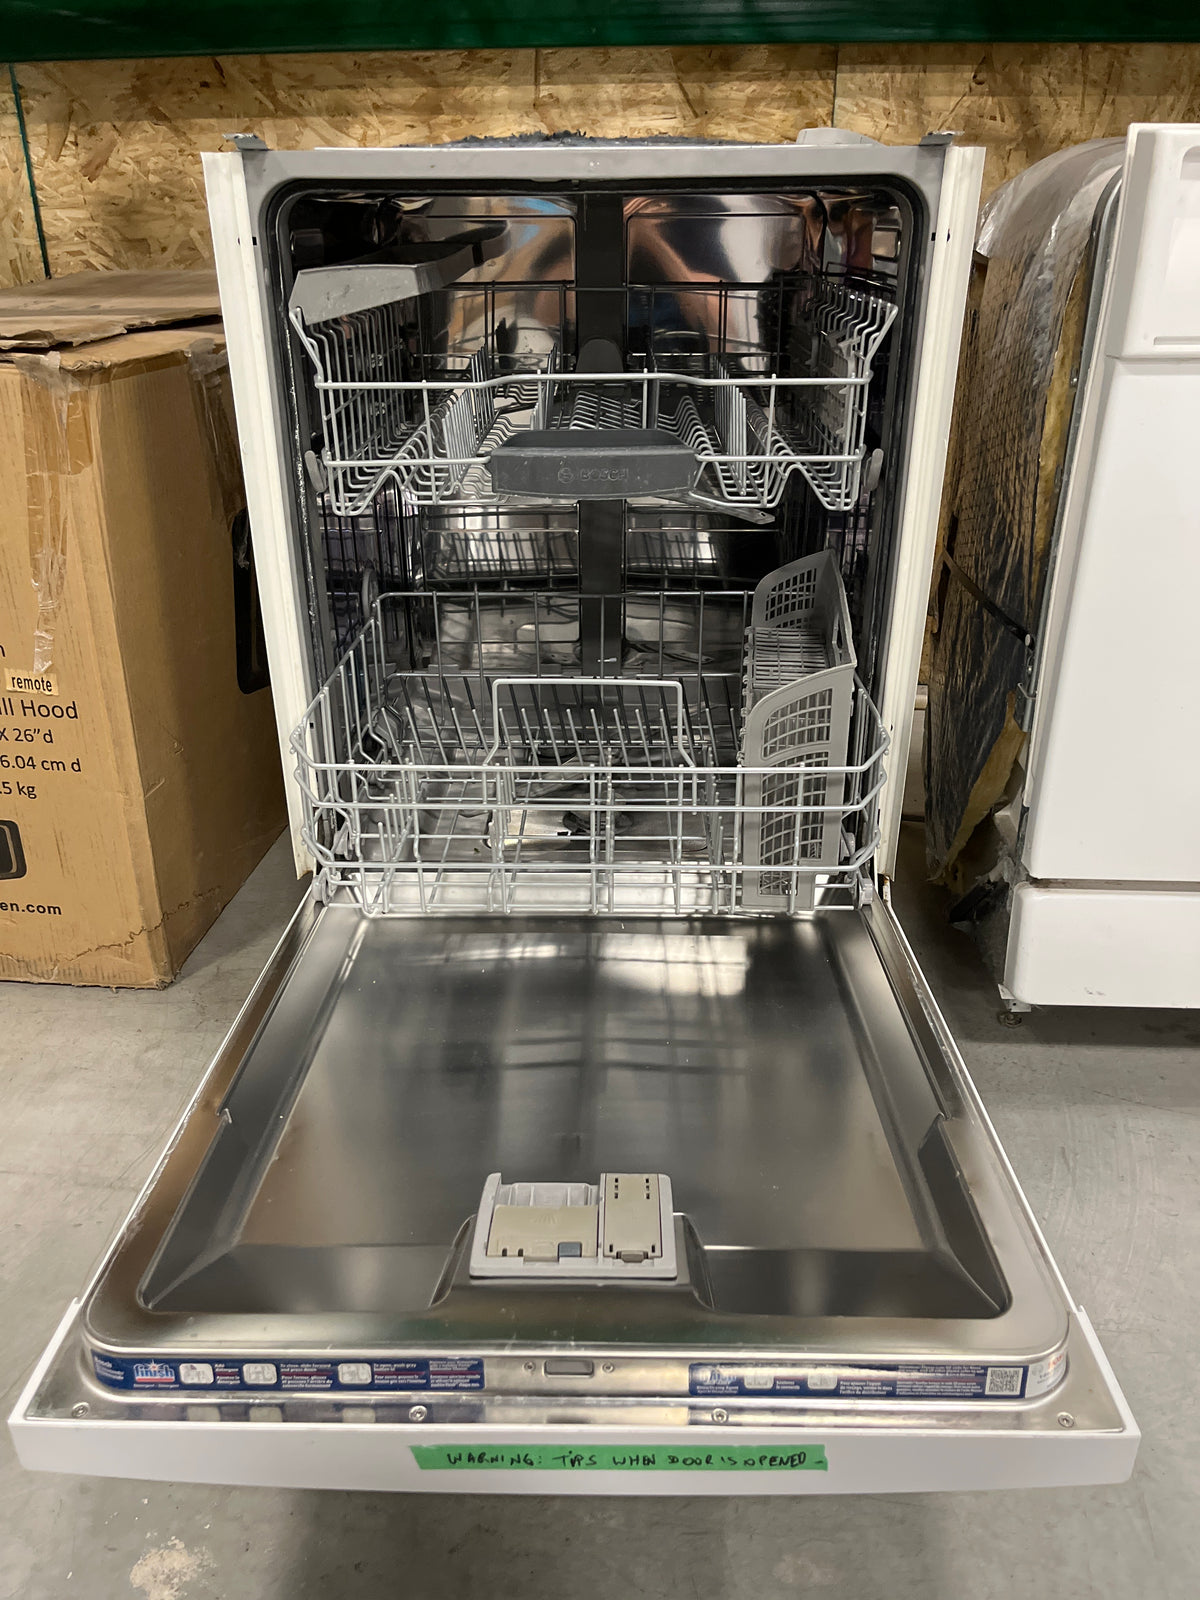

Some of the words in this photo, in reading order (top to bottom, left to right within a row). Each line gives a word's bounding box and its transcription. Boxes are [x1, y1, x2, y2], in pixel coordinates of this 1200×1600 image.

[11, 676, 52, 692] remote
[21, 699, 78, 719] Hood
[41, 759, 66, 772] cm
[71, 757, 81, 772] d
[16, 781, 37, 799] kg
[133, 1363, 175, 1378] finish
[447, 1452, 542, 1467] WARNING:
[613, 1454, 656, 1466] WHEN
[668, 1455, 713, 1466] DOOR
